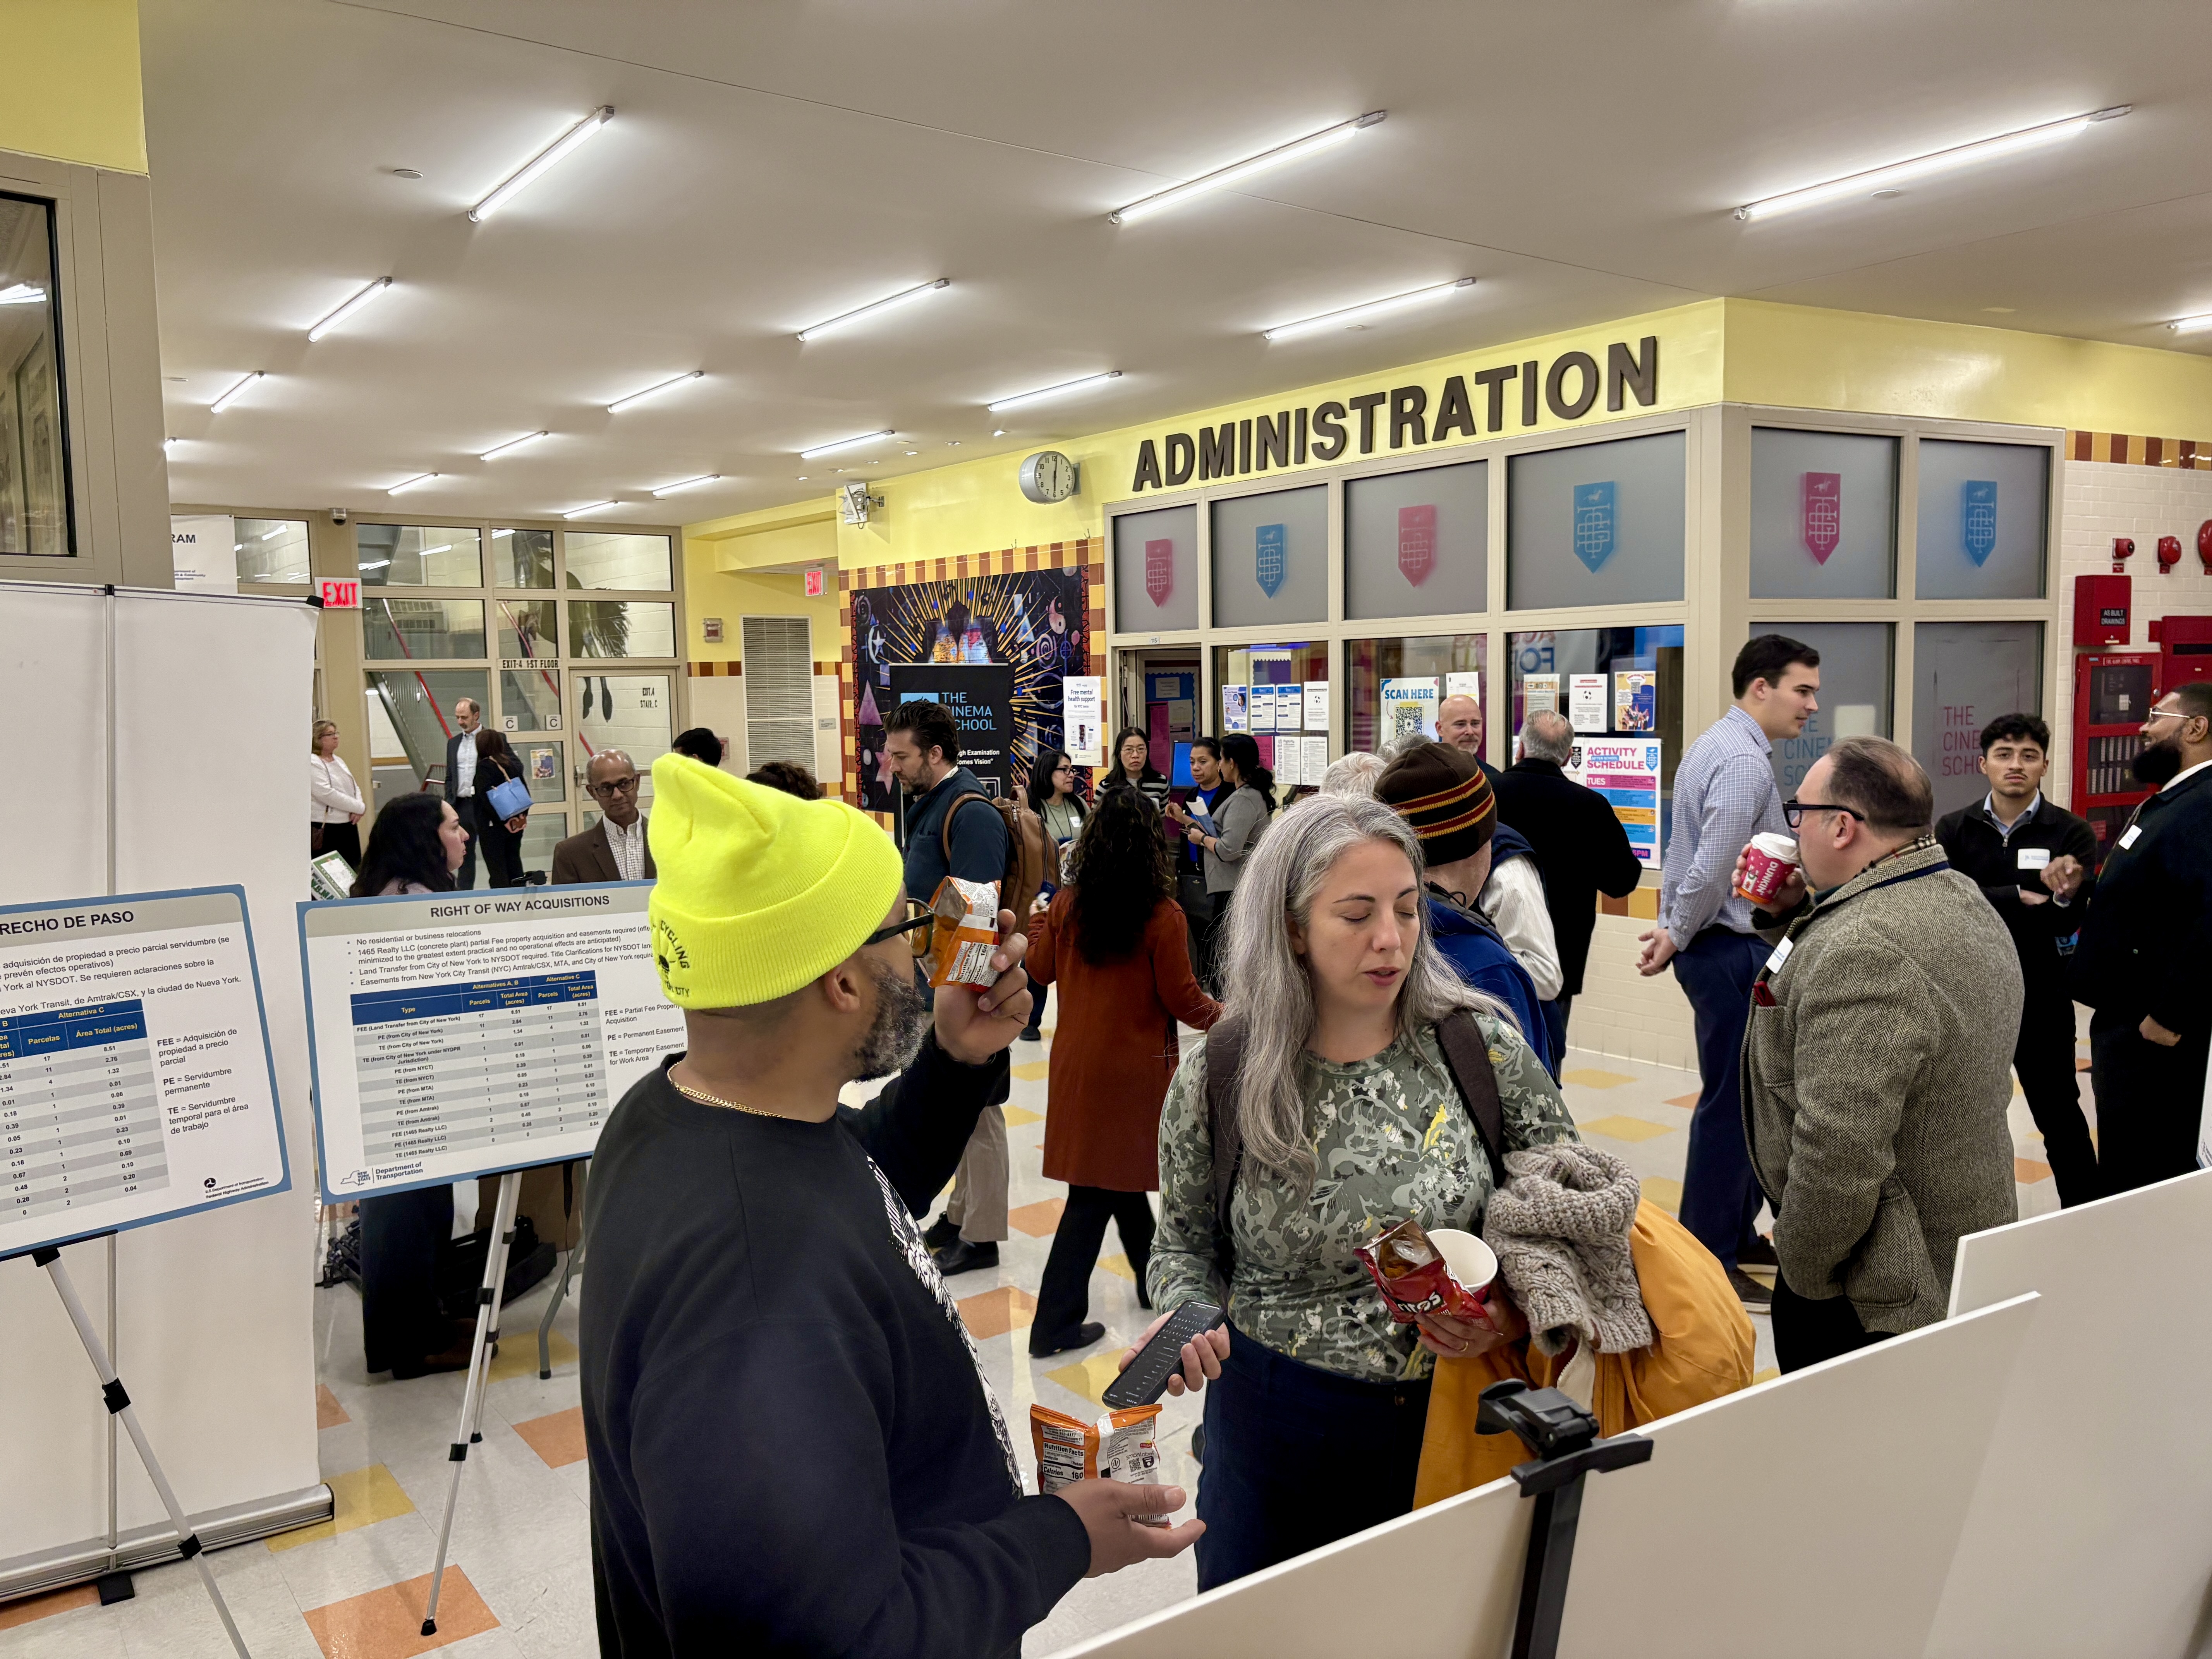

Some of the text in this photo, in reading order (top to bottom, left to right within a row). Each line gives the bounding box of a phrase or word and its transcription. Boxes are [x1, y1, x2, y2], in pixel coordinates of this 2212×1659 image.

[1132, 335, 1657, 492] ADMINISTRATION
[323, 582, 358, 607] EXIT
[540, 659, 558, 668] FLOOR
[941, 692, 967, 703] THE
[1384, 689, 1434, 699] SCAN HERE
[947, 706, 993, 717] INEMA
[1943, 706, 1975, 726] THE
[506, 720, 514, 729] C
[550, 718, 558, 727] C
[955, 719, 997, 730] CHOOL
[1943, 730, 1980, 751] CINE
[1587, 747, 1637, 757] ACTIVITY
[1784, 737, 1832, 759] CINE
[1587, 760, 1645, 770] SCHEDULE
[1587, 777, 1606, 786] TUES
[430, 895, 610, 918] RIGHT OF WAY ACQUISITIONS
[63, 915, 86, 929] DE
[90, 910, 134, 926] PASO
[369, 935, 404, 944] residential
[446, 930, 482, 938] relocations
[661, 920, 690, 969] CYCLING
[3, 957, 51, 969] adquisición
[65, 950, 106, 963] propiedad
[116, 946, 141, 957] precio
[142, 943, 168, 954] parcial
[170, 938, 216, 949] servidumbre
[218, 936, 230, 945] (se
[3, 982, 24, 991] York
[26, 981, 34, 989] al
[36, 975, 78, 988] NYSDOT.
[93, 970, 132, 980] requieren
[133, 963, 182, 975] aclaraciones
[184, 960, 206, 969] sobre
[4, 959, 114, 981] prevén efectos operativos)
[18, 1003, 39, 1012] York
[40, 999, 72, 1009] Transit,
[87, 989, 139, 1003] Amtrak/CSX,
[156, 983, 183, 993] ciudad
[196, 979, 220, 988] Nueva
[222, 975, 242, 984] York.
[58, 1009, 97, 1019] Alternativa
[624, 1006, 643, 1014] Partial
[605, 1016, 637, 1025] Acquisition
[76, 1023, 138, 1038] Área Total (acres)
[623, 1029, 655, 1039] Permanent
[656, 1026, 684, 1035] Easement
[28, 1036, 60, 1045] Parcelas
[157, 1037, 175, 1047] FEE
[183, 1030, 226, 1043] Adquisición
[158, 1044, 197, 1058] propiedad
[205, 1039, 229, 1051] precio
[624, 1046, 655, 1055] Temporary
[656, 1042, 684, 1051] Easement
[160, 1055, 186, 1068] parcial
[163, 1068, 232, 1086] PE Servidumbre
[164, 1082, 210, 1097] permanente
[167, 1097, 236, 1115] TE Servidumbre
[169, 1104, 249, 1125] temporal para el área
[182, 1121, 209, 1132] trabajo
[375, 1163, 414, 1175] Department
[376, 1168, 424, 1180] Transportation
[1044, 1443, 1068, 1453] Nutrition
[1044, 1467, 1083, 1479] Calories 160
